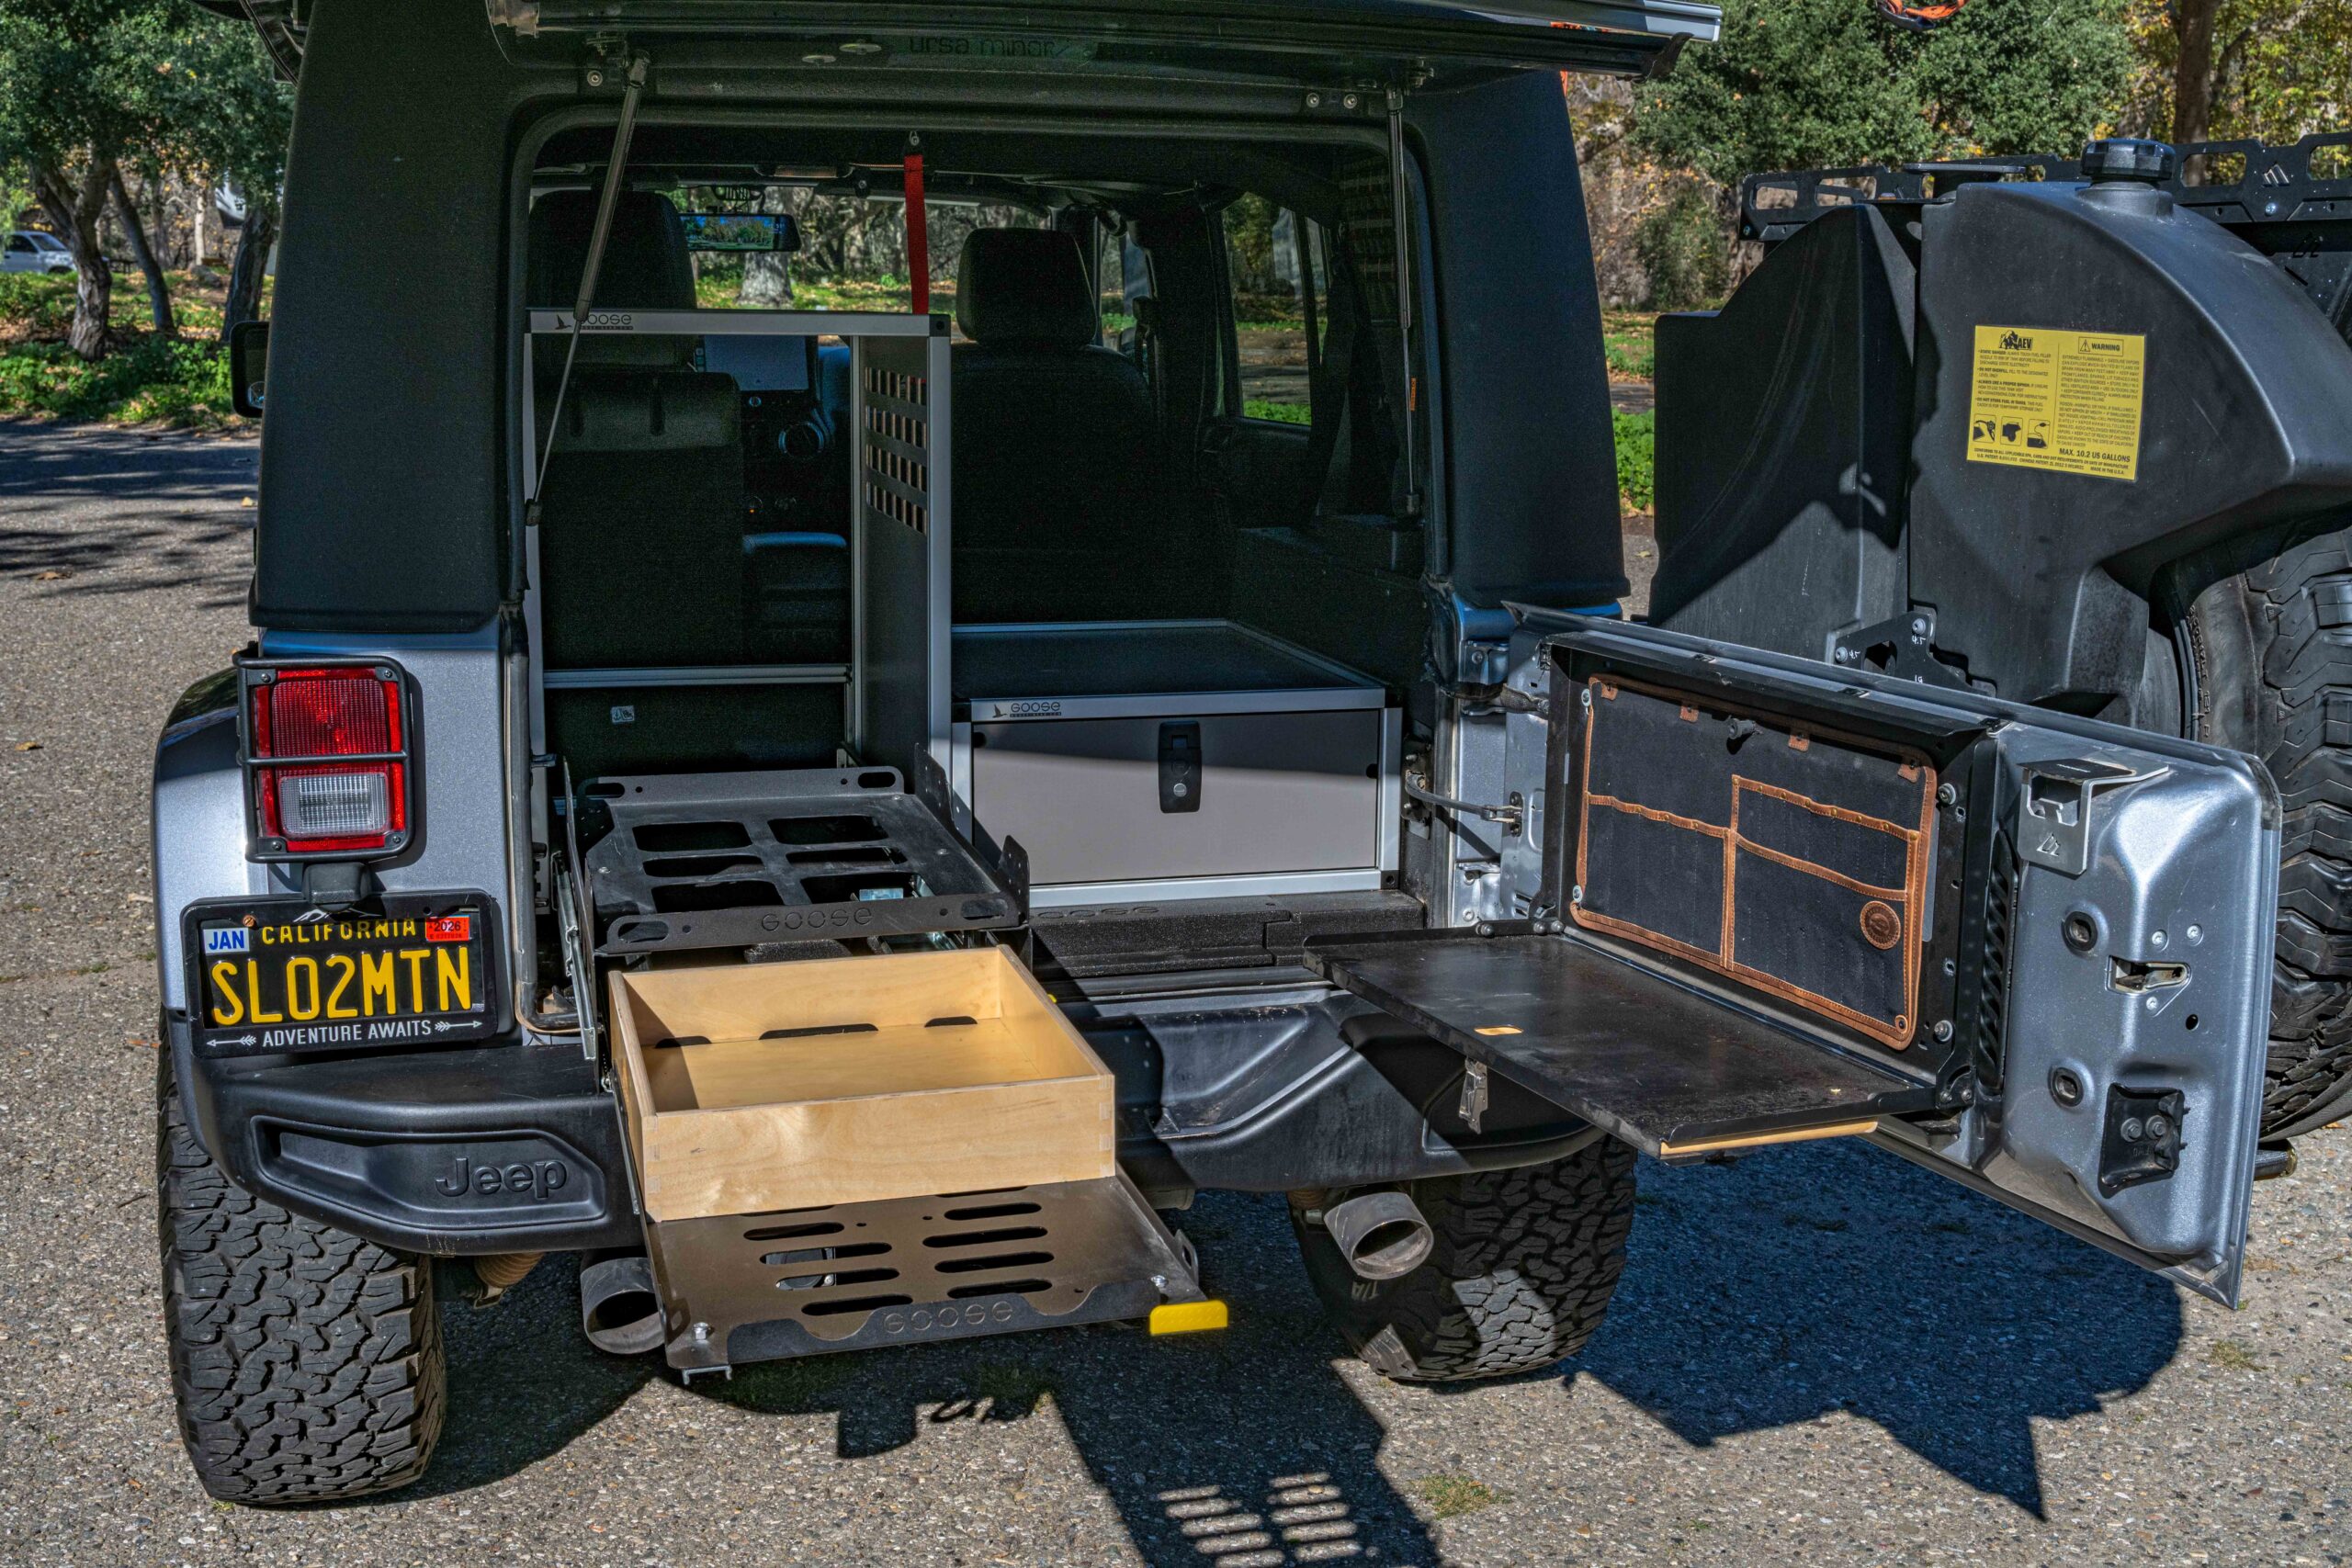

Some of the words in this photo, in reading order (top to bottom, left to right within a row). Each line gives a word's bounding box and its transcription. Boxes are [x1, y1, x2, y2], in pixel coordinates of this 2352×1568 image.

[909, 36, 969, 54] ursa
[2018, 338, 2031, 349] AEV
[2091, 343, 2120, 352] WARNING
[2059, 447, 2075, 456] MAX.
[2076, 449, 2091, 457] 10.2
[2101, 452, 2131, 463] GALLONS
[262, 919, 416, 945] CALIFORNIA
[434, 920, 461, 932] 2026
[209, 931, 245, 953] JAN
[263, 1024, 362, 1047] ADVENTURE
[368, 1020, 432, 1040] AWAITS
[435, 1157, 567, 1199] Jeep
